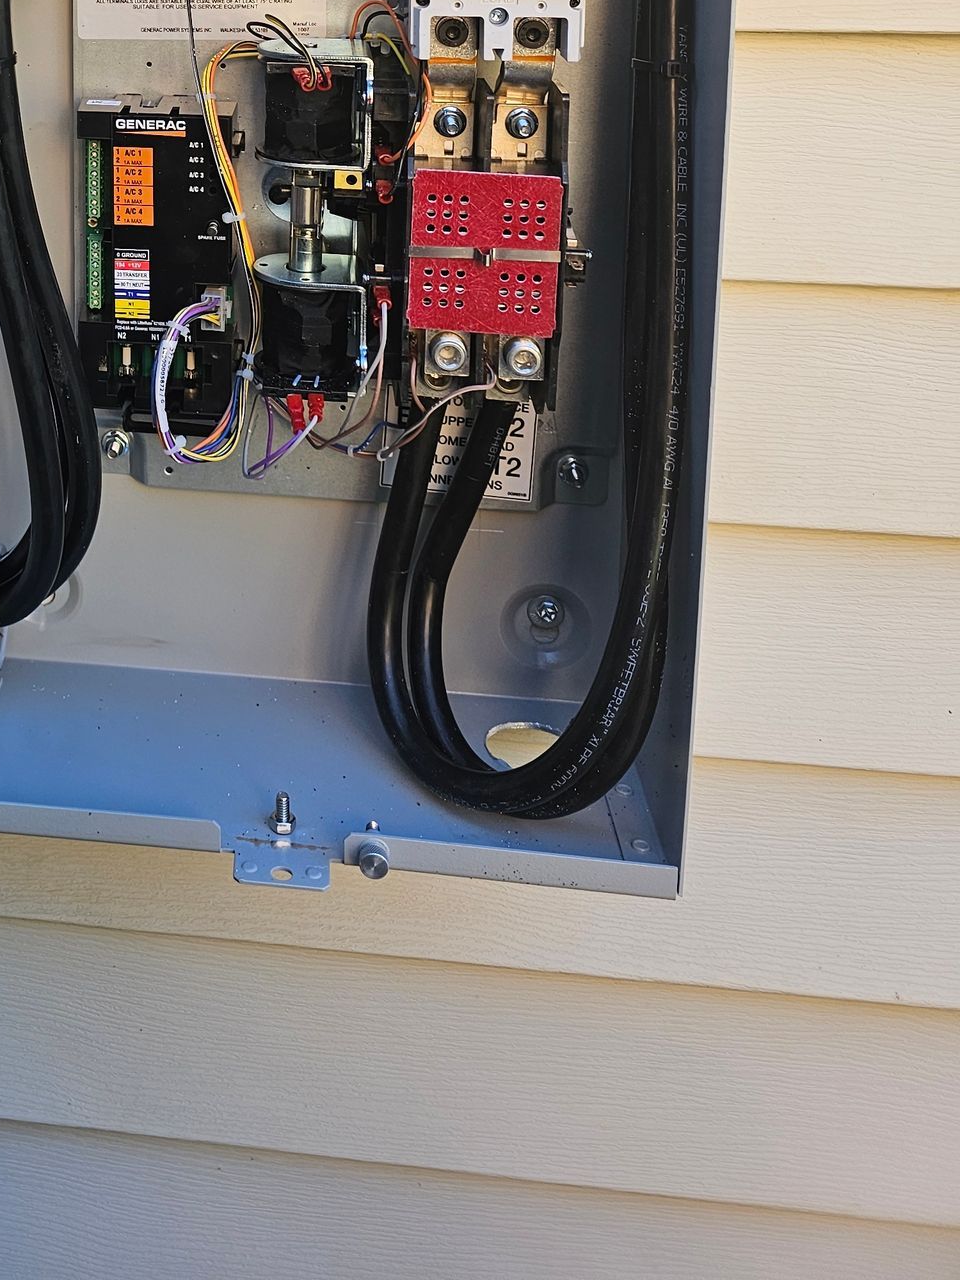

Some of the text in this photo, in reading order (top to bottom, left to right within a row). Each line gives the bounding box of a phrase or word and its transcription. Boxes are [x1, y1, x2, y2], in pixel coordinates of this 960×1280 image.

[678, 25, 689, 82] YANCY
[677, 87, 688, 126] WIRE
[115, 119, 187, 131] GENERAC
[677, 131, 688, 142] &
[677, 146, 688, 192] CABLE
[677, 202, 688, 228] INC
[674, 233, 688, 263] (UL)
[117, 332, 127, 340] N2
[667, 405, 680, 431] 4/0
[662, 434, 679, 472] AWG
